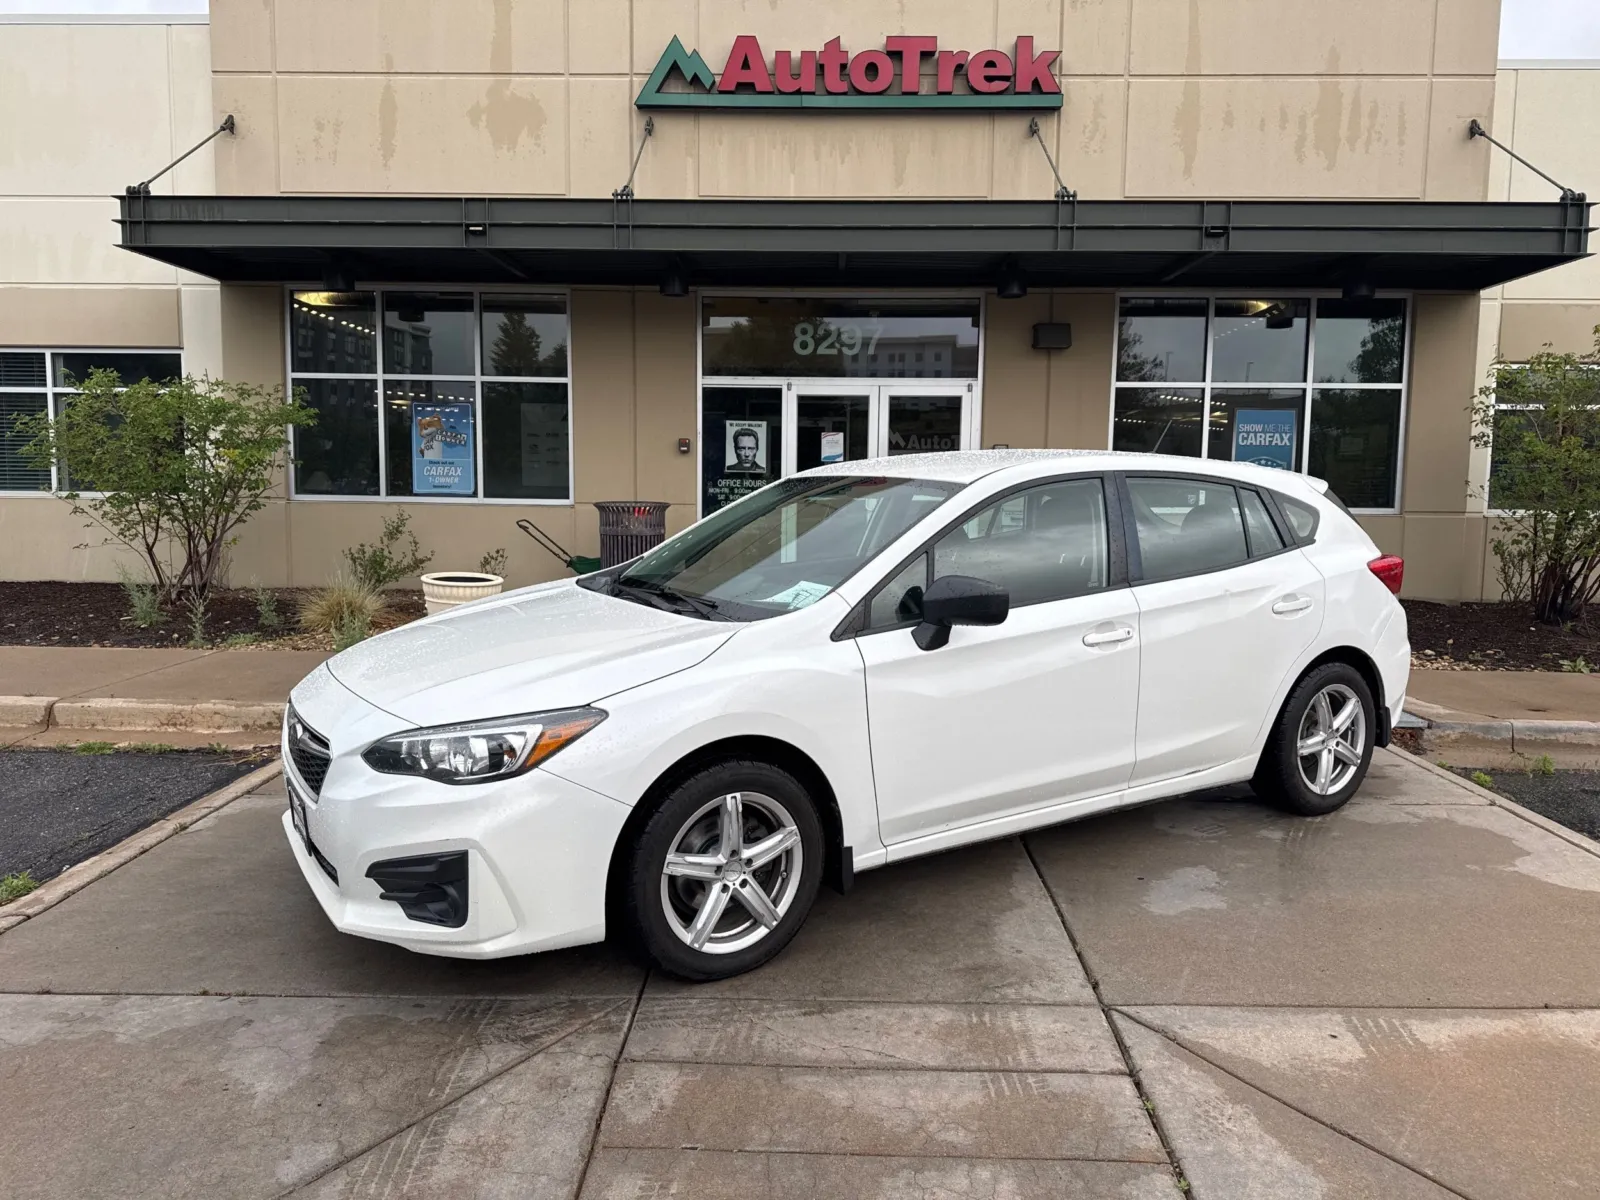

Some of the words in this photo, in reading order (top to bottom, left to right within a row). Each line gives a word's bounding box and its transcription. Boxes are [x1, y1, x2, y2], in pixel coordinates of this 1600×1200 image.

[717, 35, 1063, 94] AutoTrek
[793, 322, 884, 356] 8297
[1238, 423, 1264, 432] SHOW
[1264, 424, 1276, 432] ME
[1277, 424, 1292, 432] THE
[1238, 432, 1291, 446] CARFAX
[423, 466, 462, 476] CARFAX
[717, 479, 741, 487] OFFICE
[743, 479, 767, 487] HOURS
